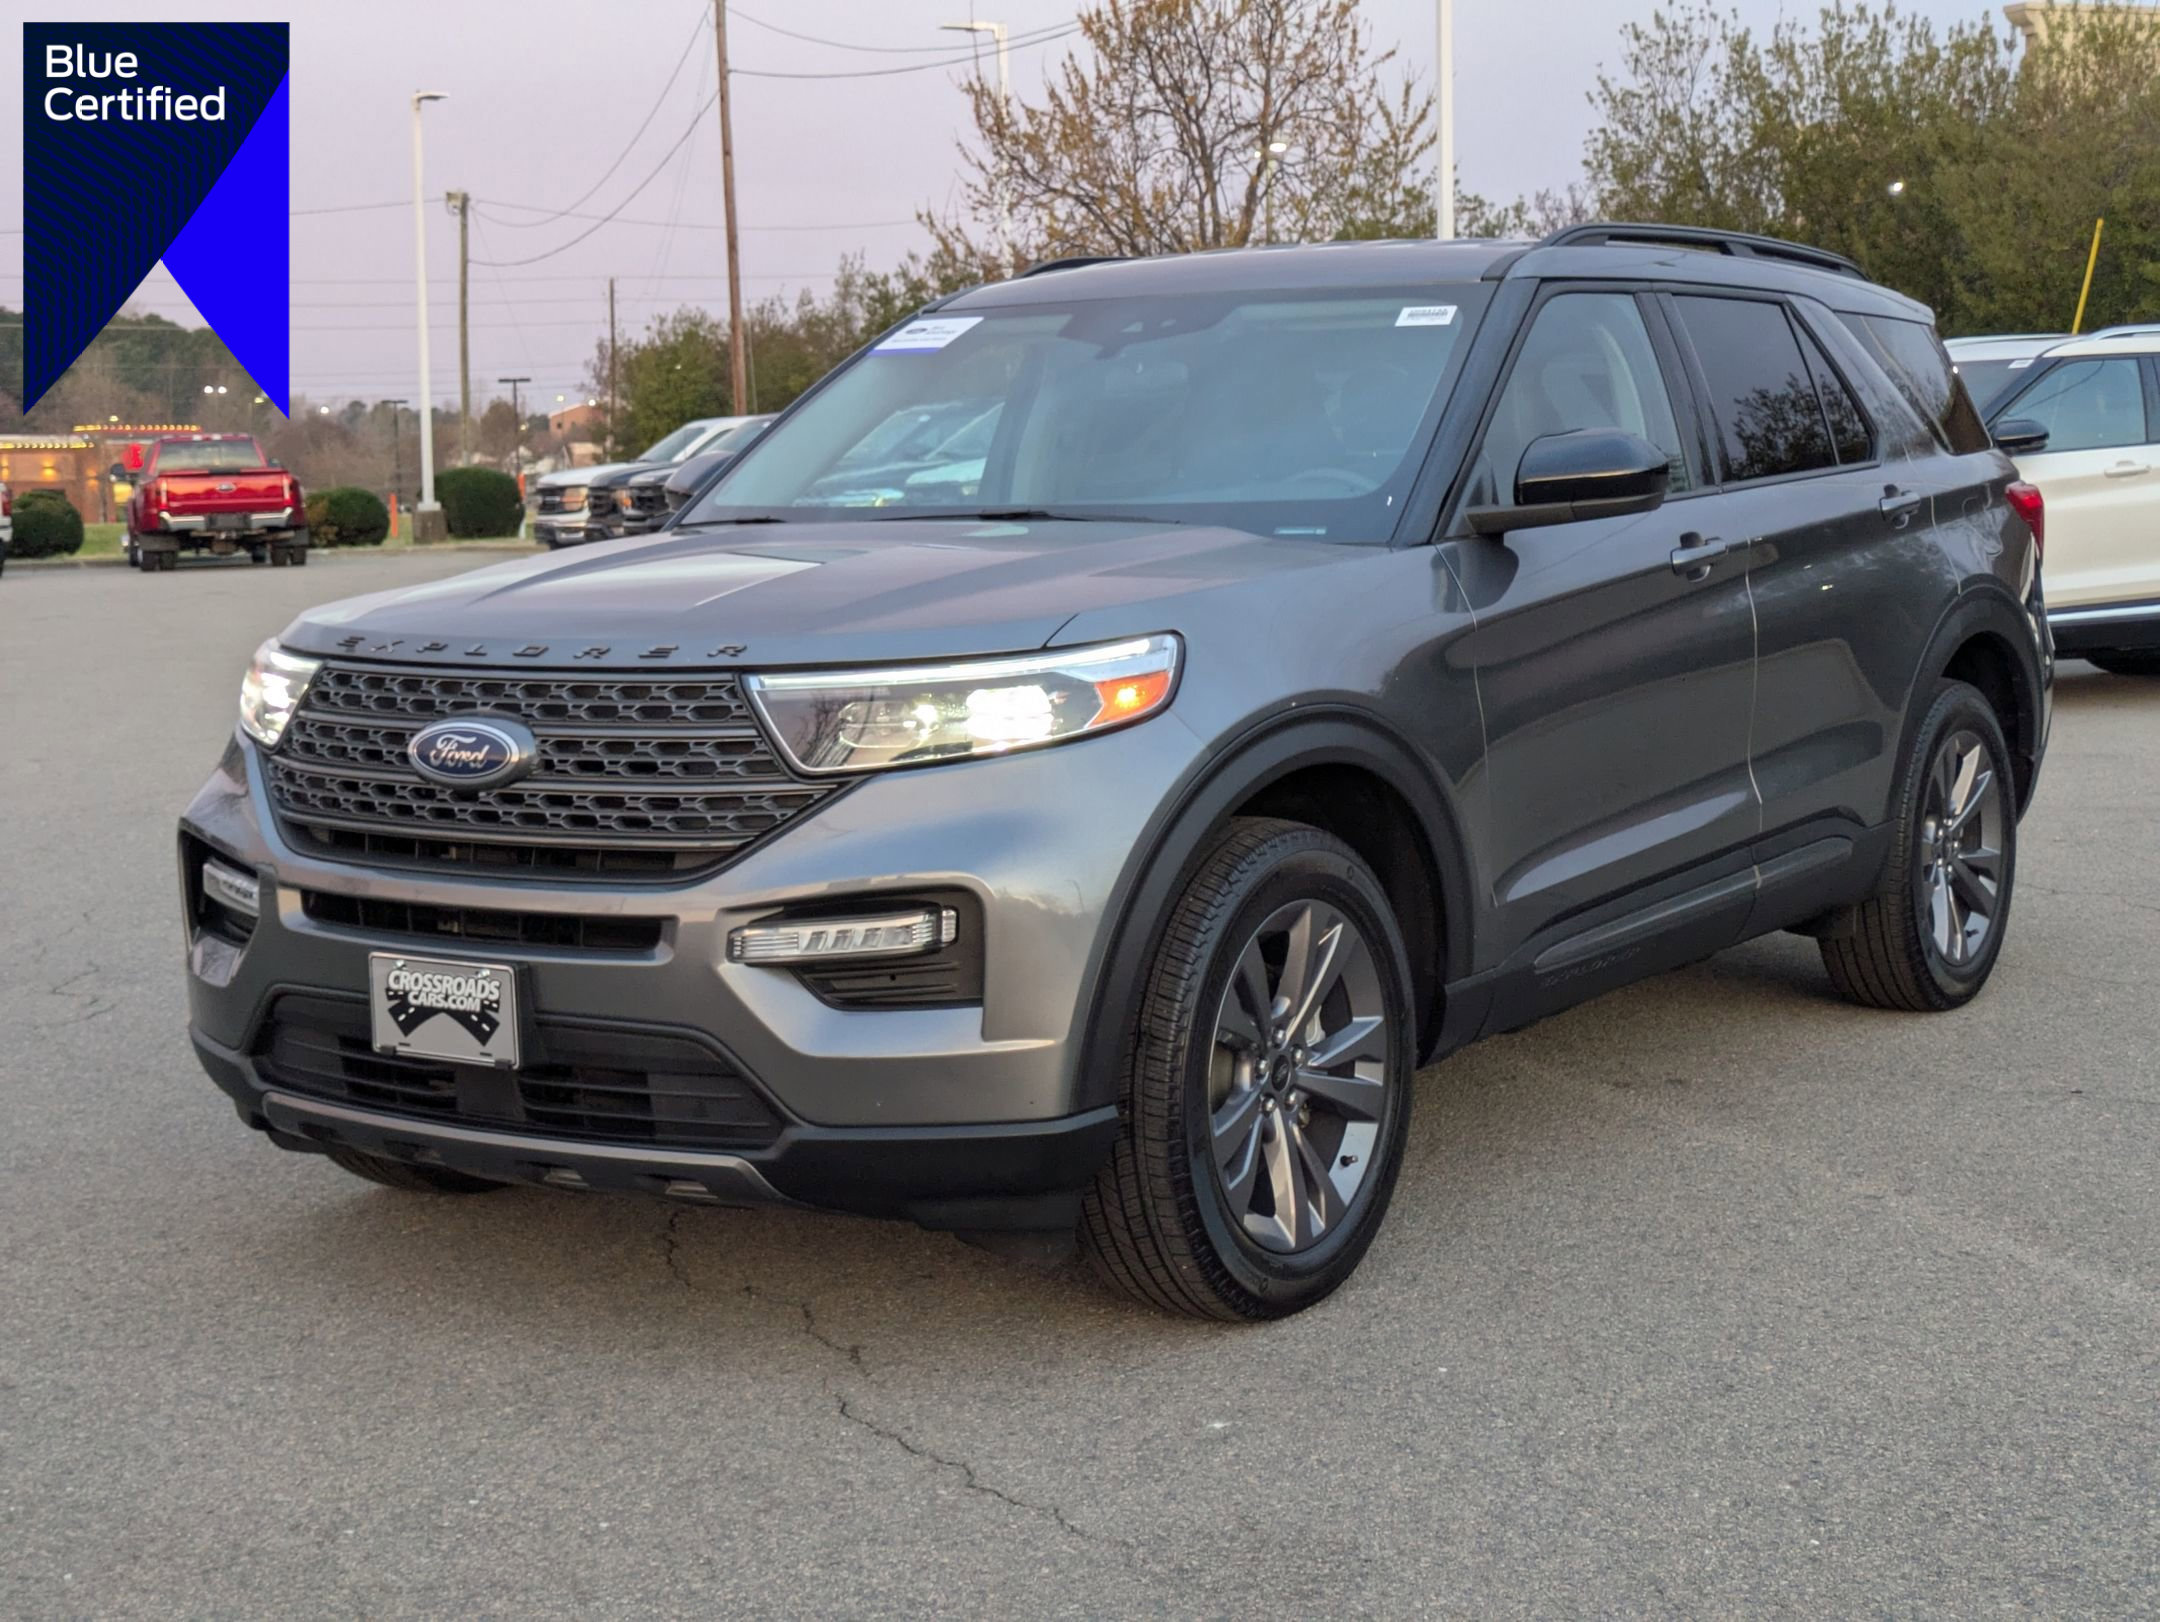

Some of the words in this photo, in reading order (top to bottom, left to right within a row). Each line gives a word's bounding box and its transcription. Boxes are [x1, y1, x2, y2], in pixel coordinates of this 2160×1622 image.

[336, 636, 749, 660] EXPLORER
[429, 733, 490, 769] Ford
[388, 970, 501, 1001] CROSSROADS
[407, 990, 482, 1012] CARS.COM
